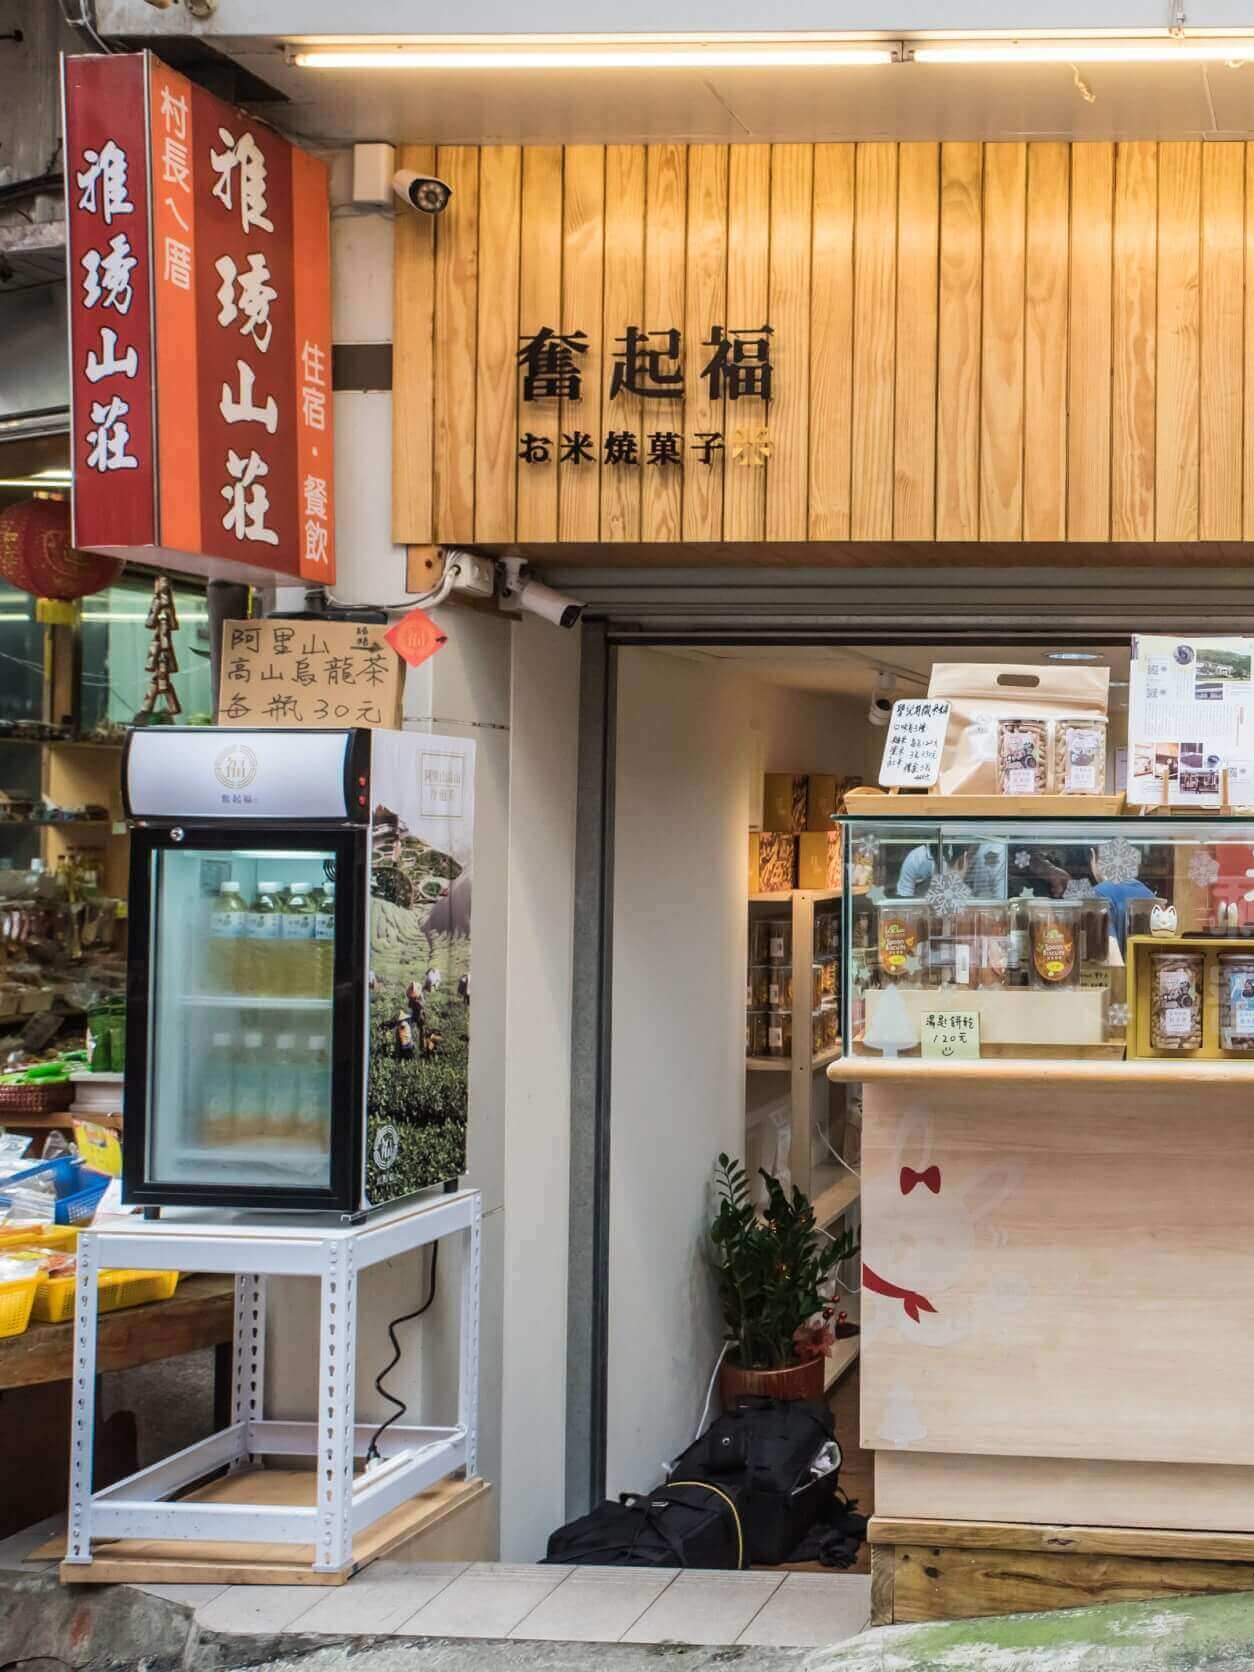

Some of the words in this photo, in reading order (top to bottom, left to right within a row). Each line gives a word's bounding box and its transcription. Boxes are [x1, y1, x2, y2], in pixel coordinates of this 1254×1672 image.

[77, 138, 139, 473] 雅琇山莊
[208, 126, 281, 547] 雅琇山莊
[517, 325, 774, 401] 奮起福
[227, 655, 389, 687] 高山烏龍茶
[230, 627, 330, 656] 阿里山
